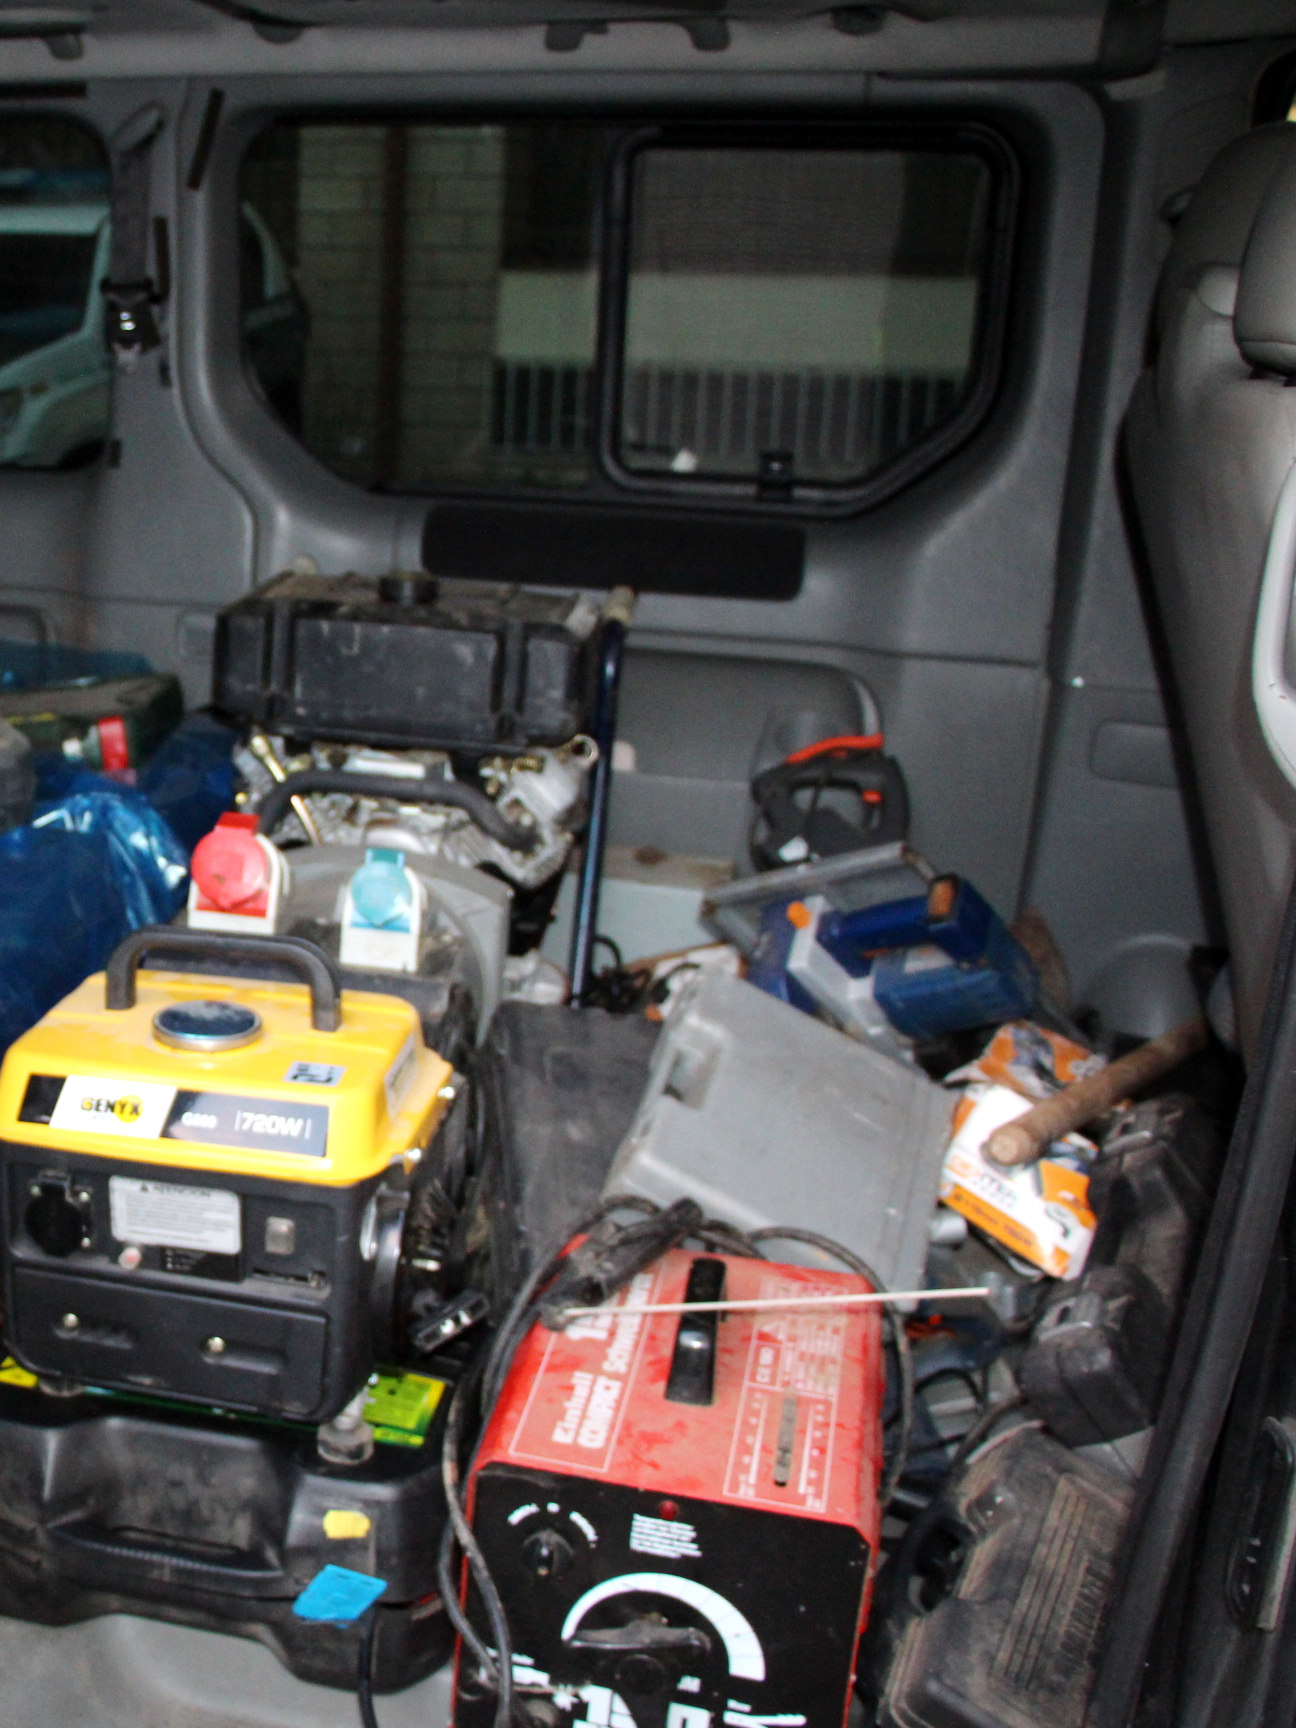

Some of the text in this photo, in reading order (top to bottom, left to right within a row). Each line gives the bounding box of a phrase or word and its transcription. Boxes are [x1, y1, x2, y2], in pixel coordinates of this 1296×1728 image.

[80, 1096, 141, 1117] GENYX
[241, 1112, 304, 1137] 720W
[551, 1370, 594, 1444] Einhell
[576, 1374, 623, 1448] COMPACT
